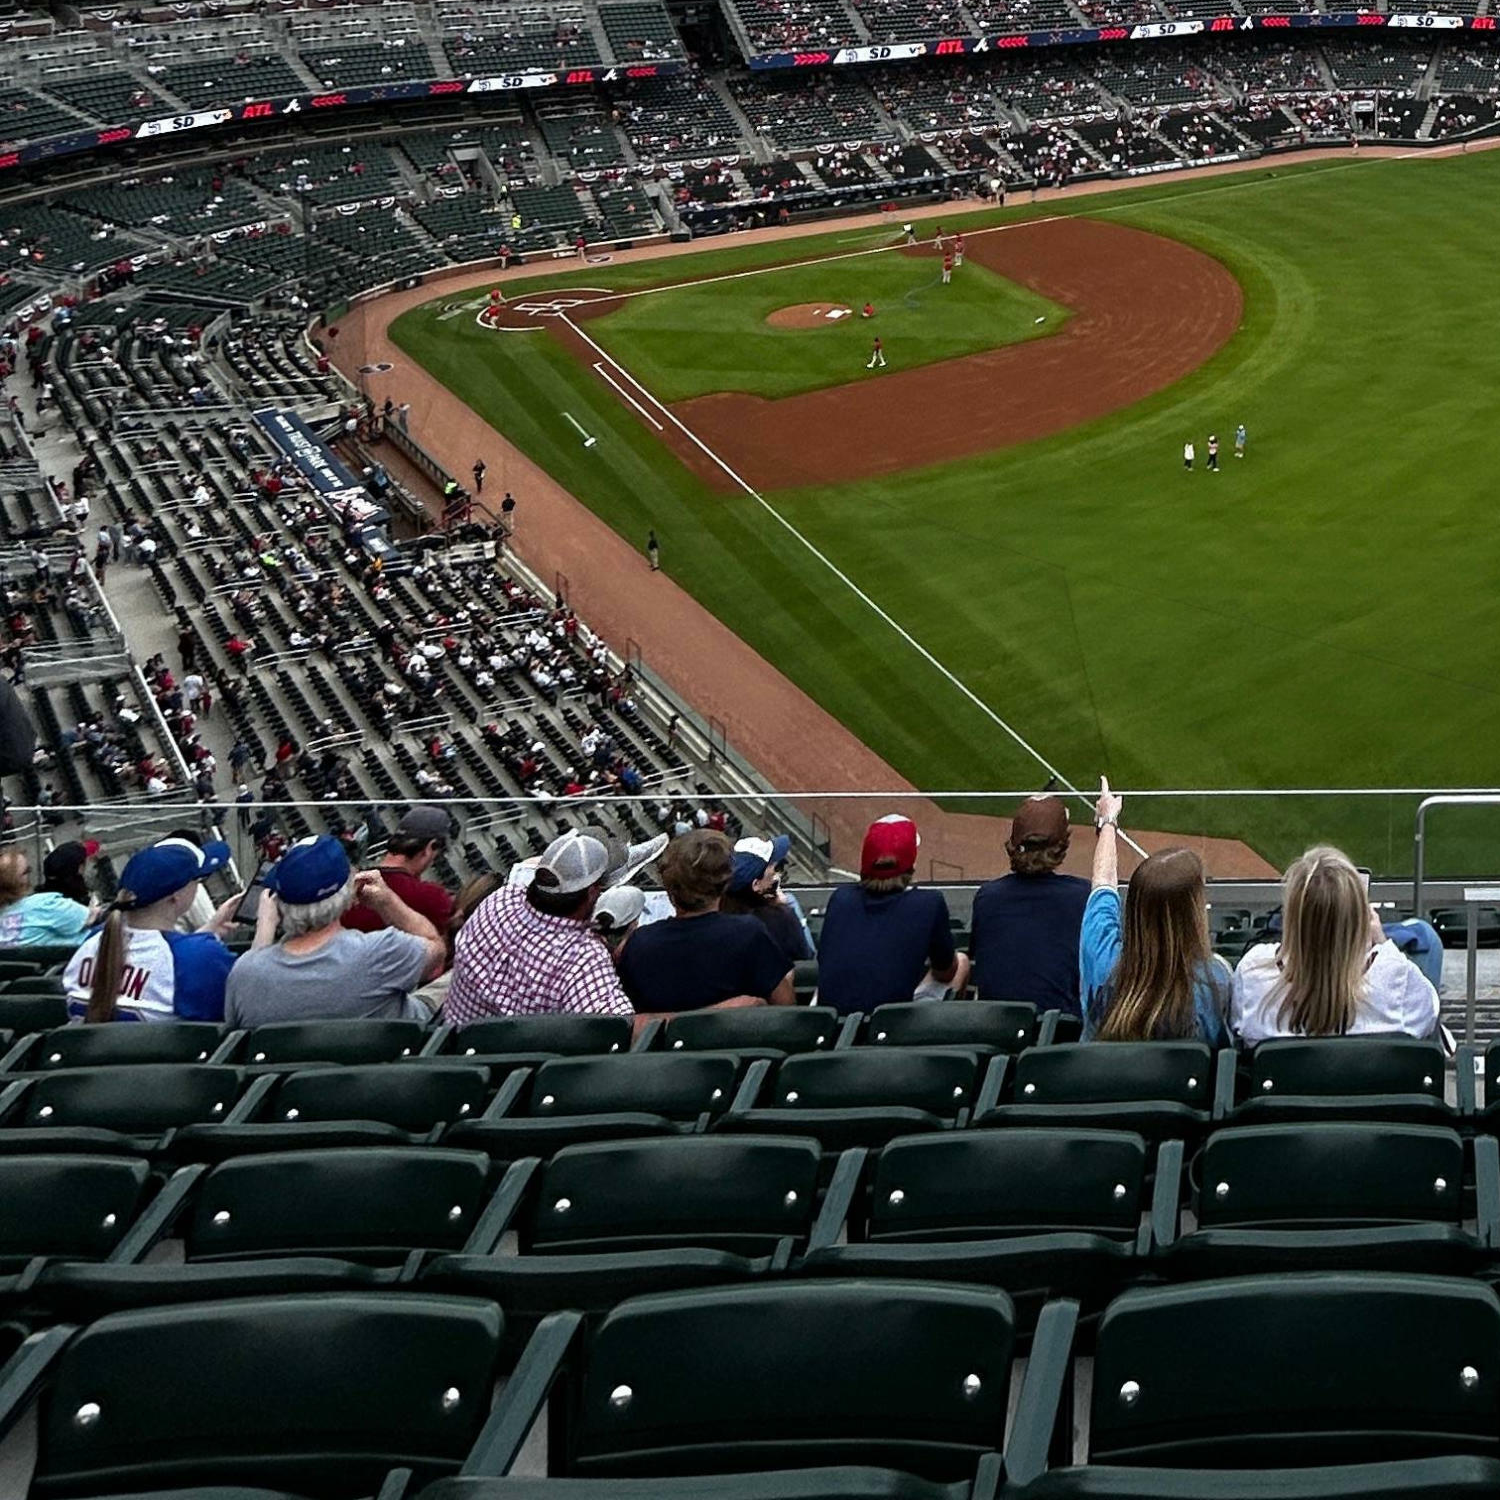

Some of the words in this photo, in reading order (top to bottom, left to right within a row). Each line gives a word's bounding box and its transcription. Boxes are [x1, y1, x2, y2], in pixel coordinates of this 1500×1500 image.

[1159, 24, 1176, 35] SD
[1211, 18, 1234, 31] ATL
[1416, 17, 1434, 26] SD
[869, 47, 891, 59] SD
[935, 40, 964, 55] ATL
[502, 78, 523, 88] SD
[566, 71, 594, 84] ATL
[173, 116, 195, 130] SD
[242, 103, 273, 119] ATL
[79, 957, 150, 1000] OON
